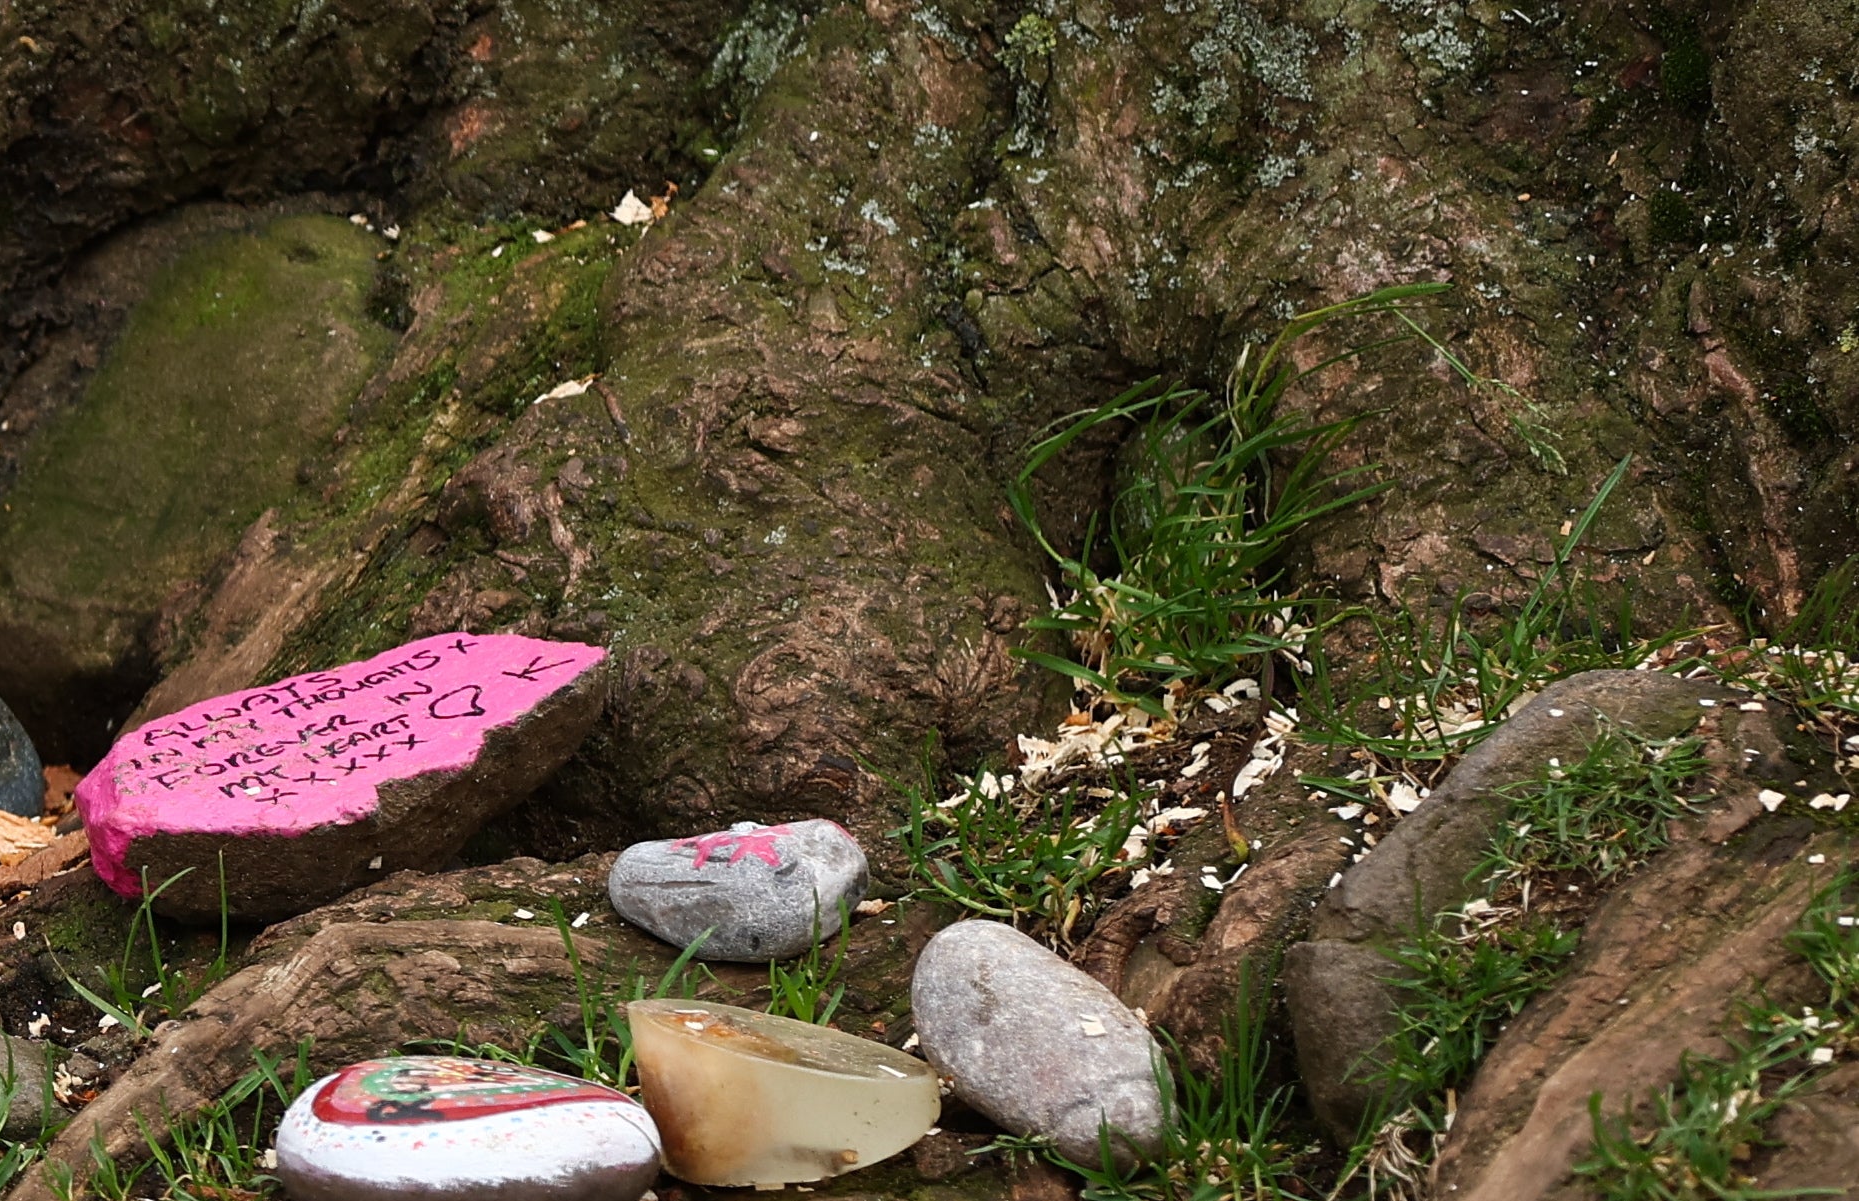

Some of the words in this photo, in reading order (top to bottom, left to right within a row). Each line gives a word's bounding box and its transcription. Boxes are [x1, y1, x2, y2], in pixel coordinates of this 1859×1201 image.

[271, 650, 441, 718] THOUGHTS
[149, 714, 368, 790] FOREVER
[384, 681, 433, 705] IN
[303, 713, 410, 763] HEART
